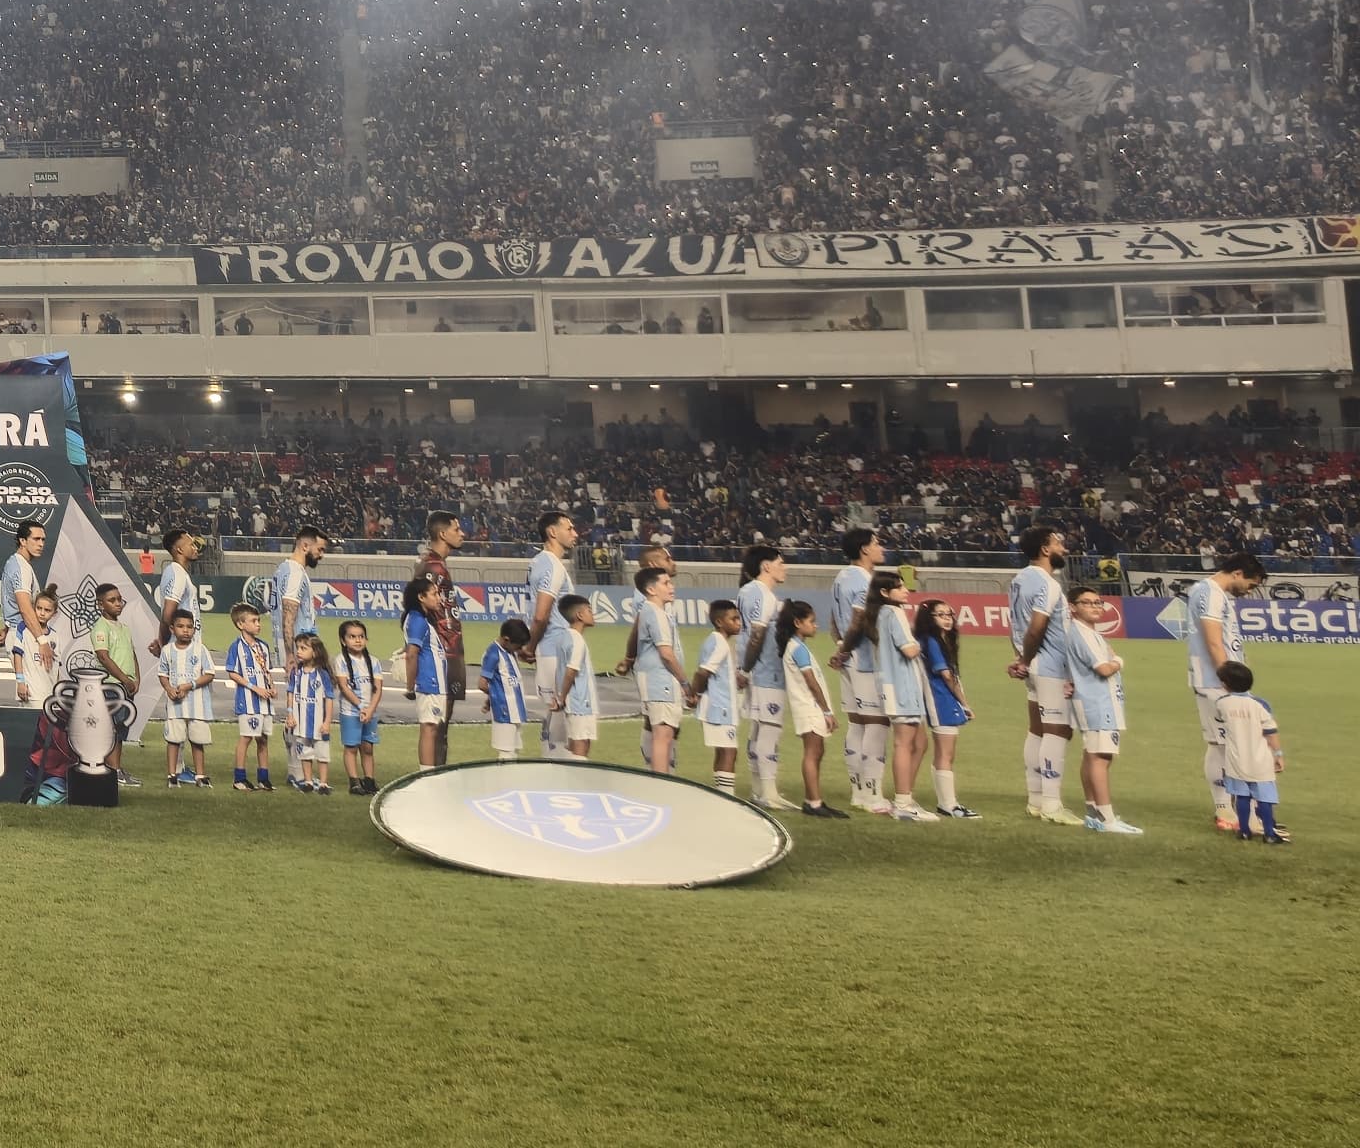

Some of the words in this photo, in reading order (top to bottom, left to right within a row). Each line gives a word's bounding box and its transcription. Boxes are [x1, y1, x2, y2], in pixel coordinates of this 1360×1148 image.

[201, 242, 473, 284] TROVÃO
[563, 233, 746, 279] AZUL
[810, 223, 1294, 266] PIRATAS
[6, 493, 59, 505] PARÁ
[25, 486, 52, 496] 30
[358, 590, 404, 611] PAR
[1238, 598, 1360, 633] stáci
